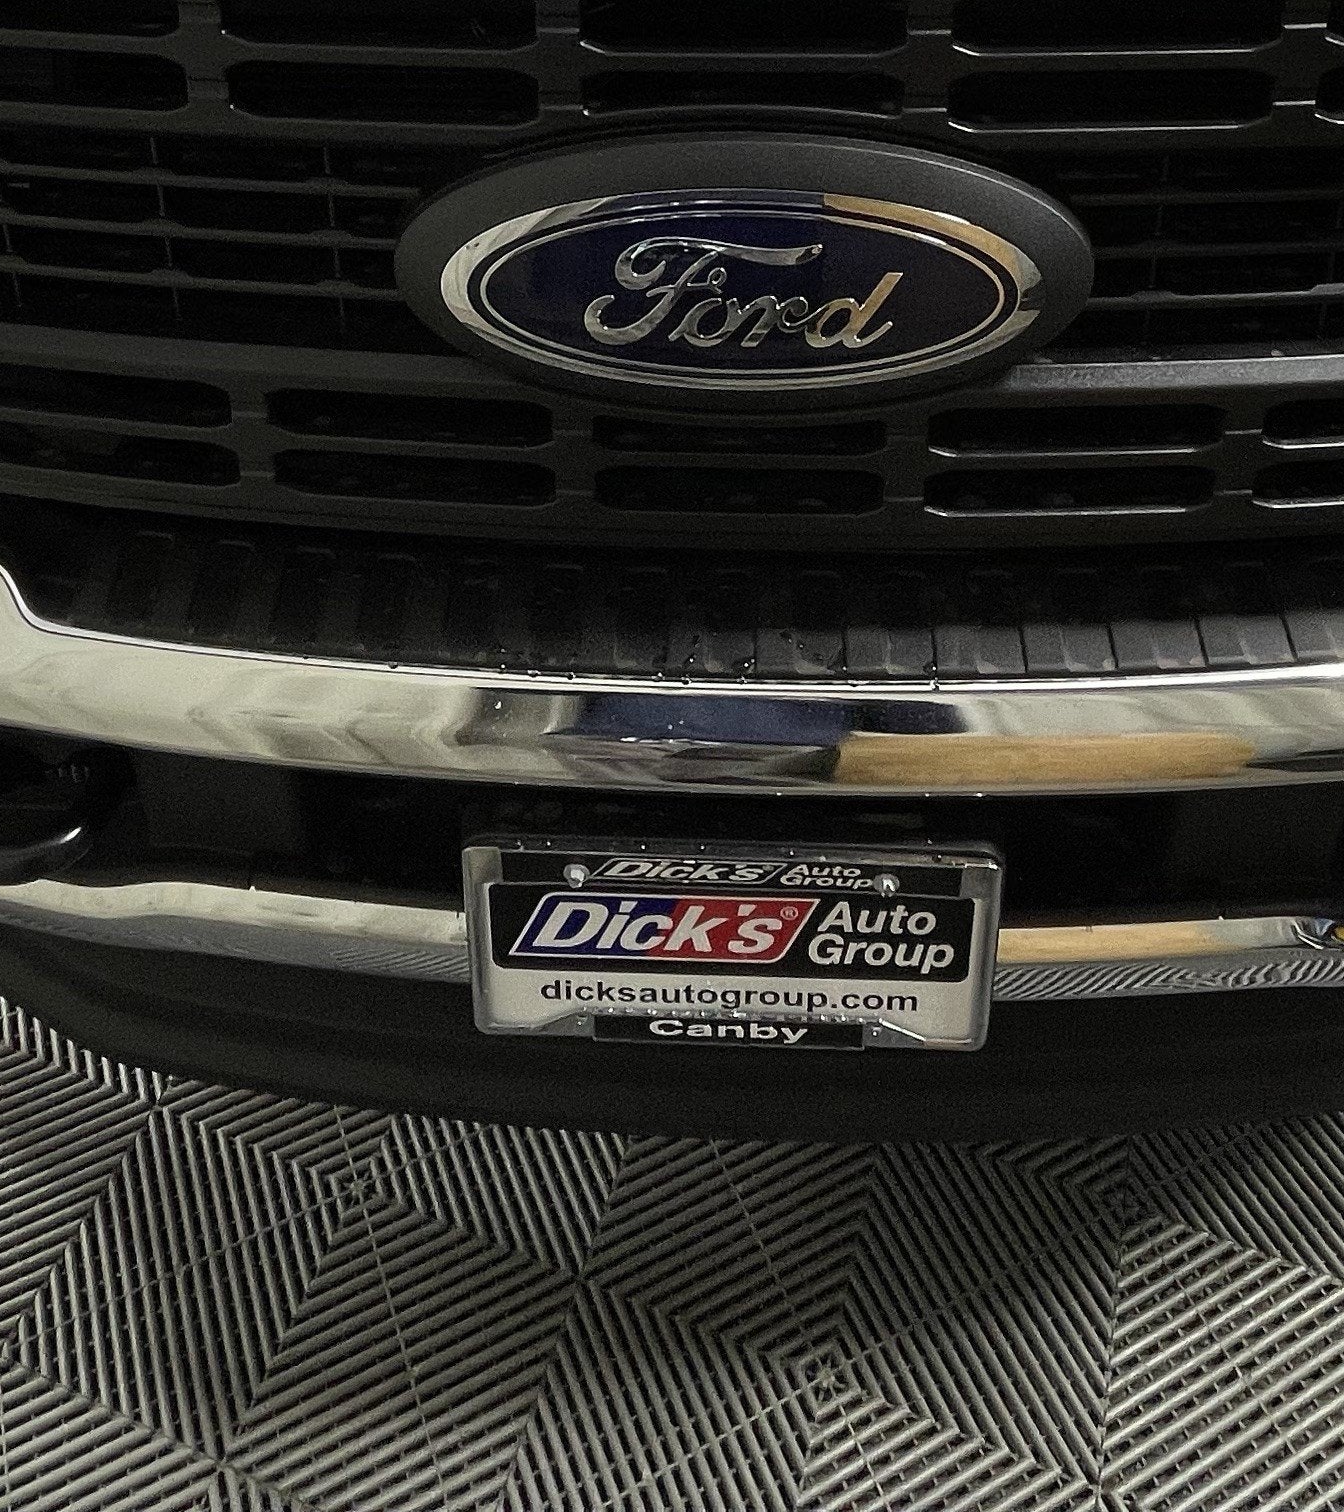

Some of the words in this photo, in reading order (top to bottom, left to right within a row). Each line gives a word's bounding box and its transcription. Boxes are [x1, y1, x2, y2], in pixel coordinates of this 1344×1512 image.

[583, 235, 904, 349] Ford
[603, 861, 766, 884] Dick's
[786, 863, 862, 878] Auto
[780, 874, 875, 890] Group
[531, 899, 781, 955] Dick's
[816, 901, 938, 936] Auto
[808, 935, 955, 975] Group
[540, 979, 919, 1012] dicksautogroup.com
[649, 1018, 809, 1044] Canby
